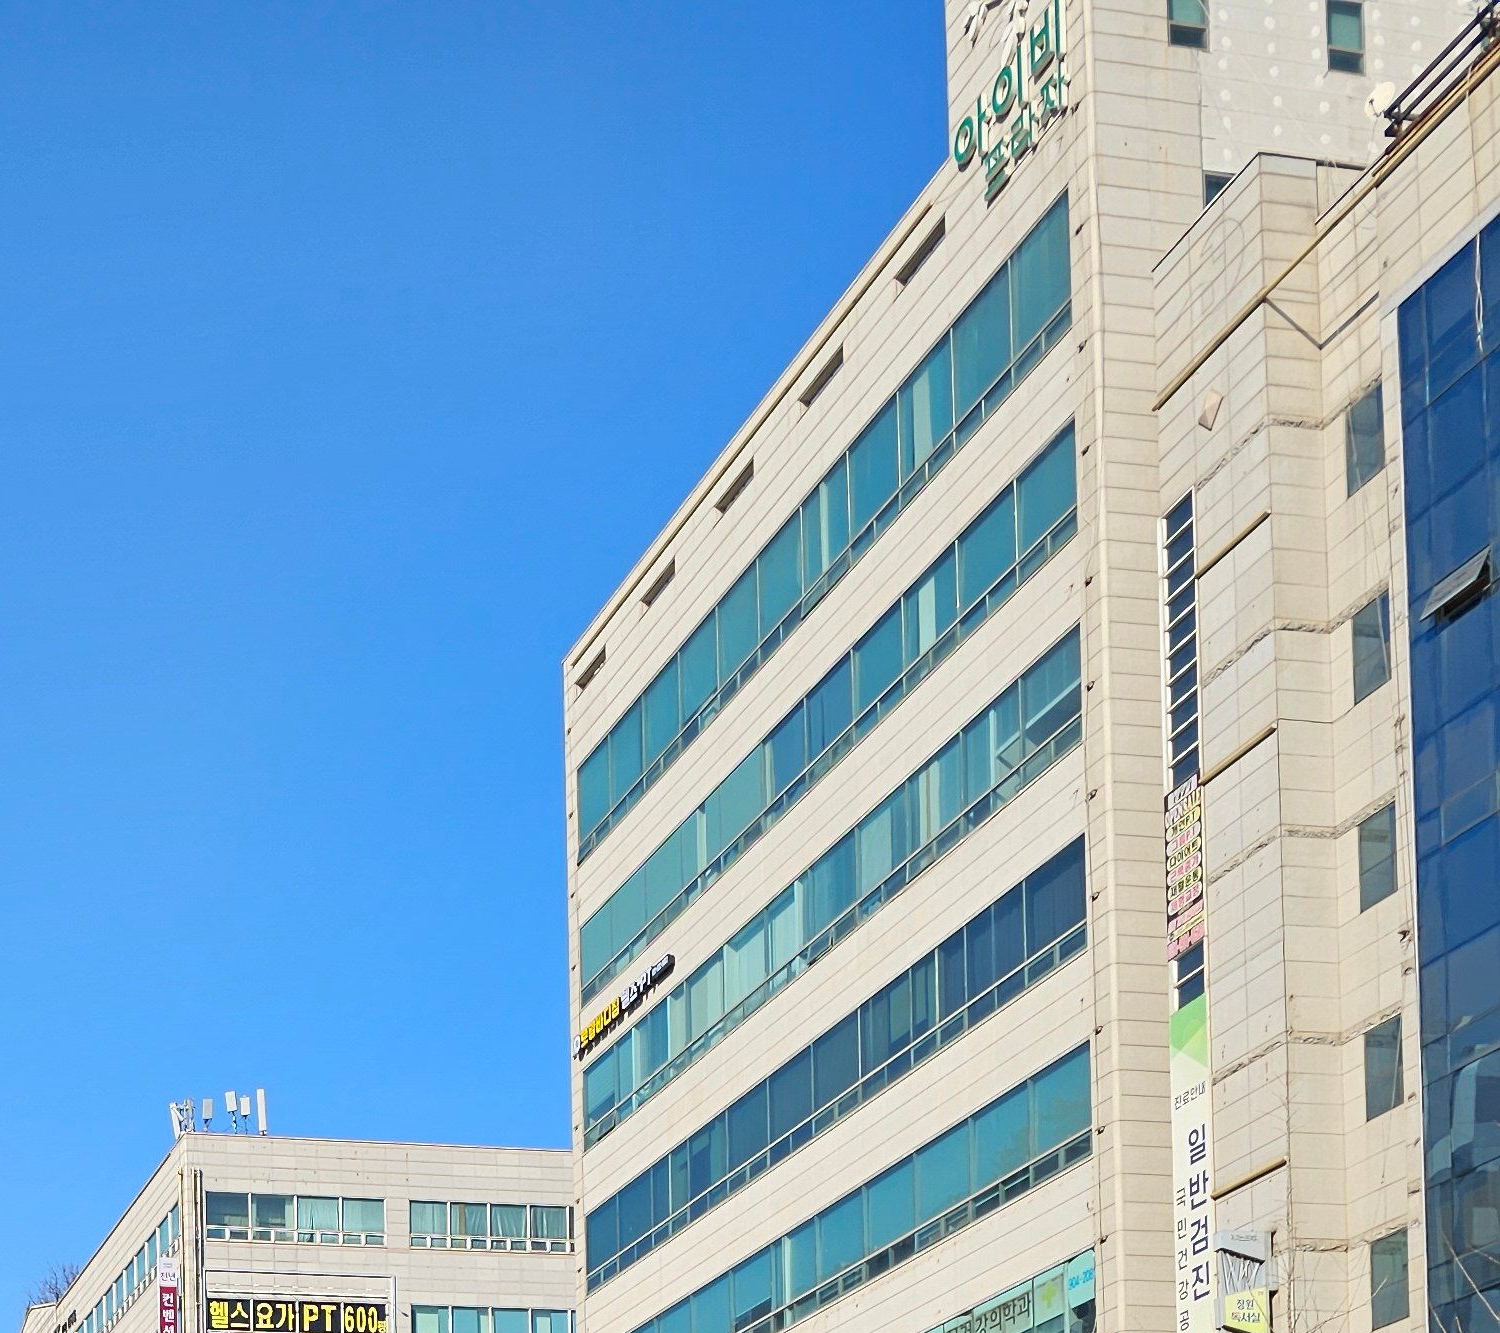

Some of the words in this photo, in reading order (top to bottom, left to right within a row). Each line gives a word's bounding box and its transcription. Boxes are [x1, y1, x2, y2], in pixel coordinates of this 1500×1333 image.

[953, 0, 1069, 166] 아이비
[1174, 1080, 1207, 1111] 진료안내
[1187, 1122, 1212, 1302] 일반검진
[209, 1299, 251, 1330] 헬스
[256, 1302, 296, 1332] 요가
[302, 1304, 338, 1333] PT
